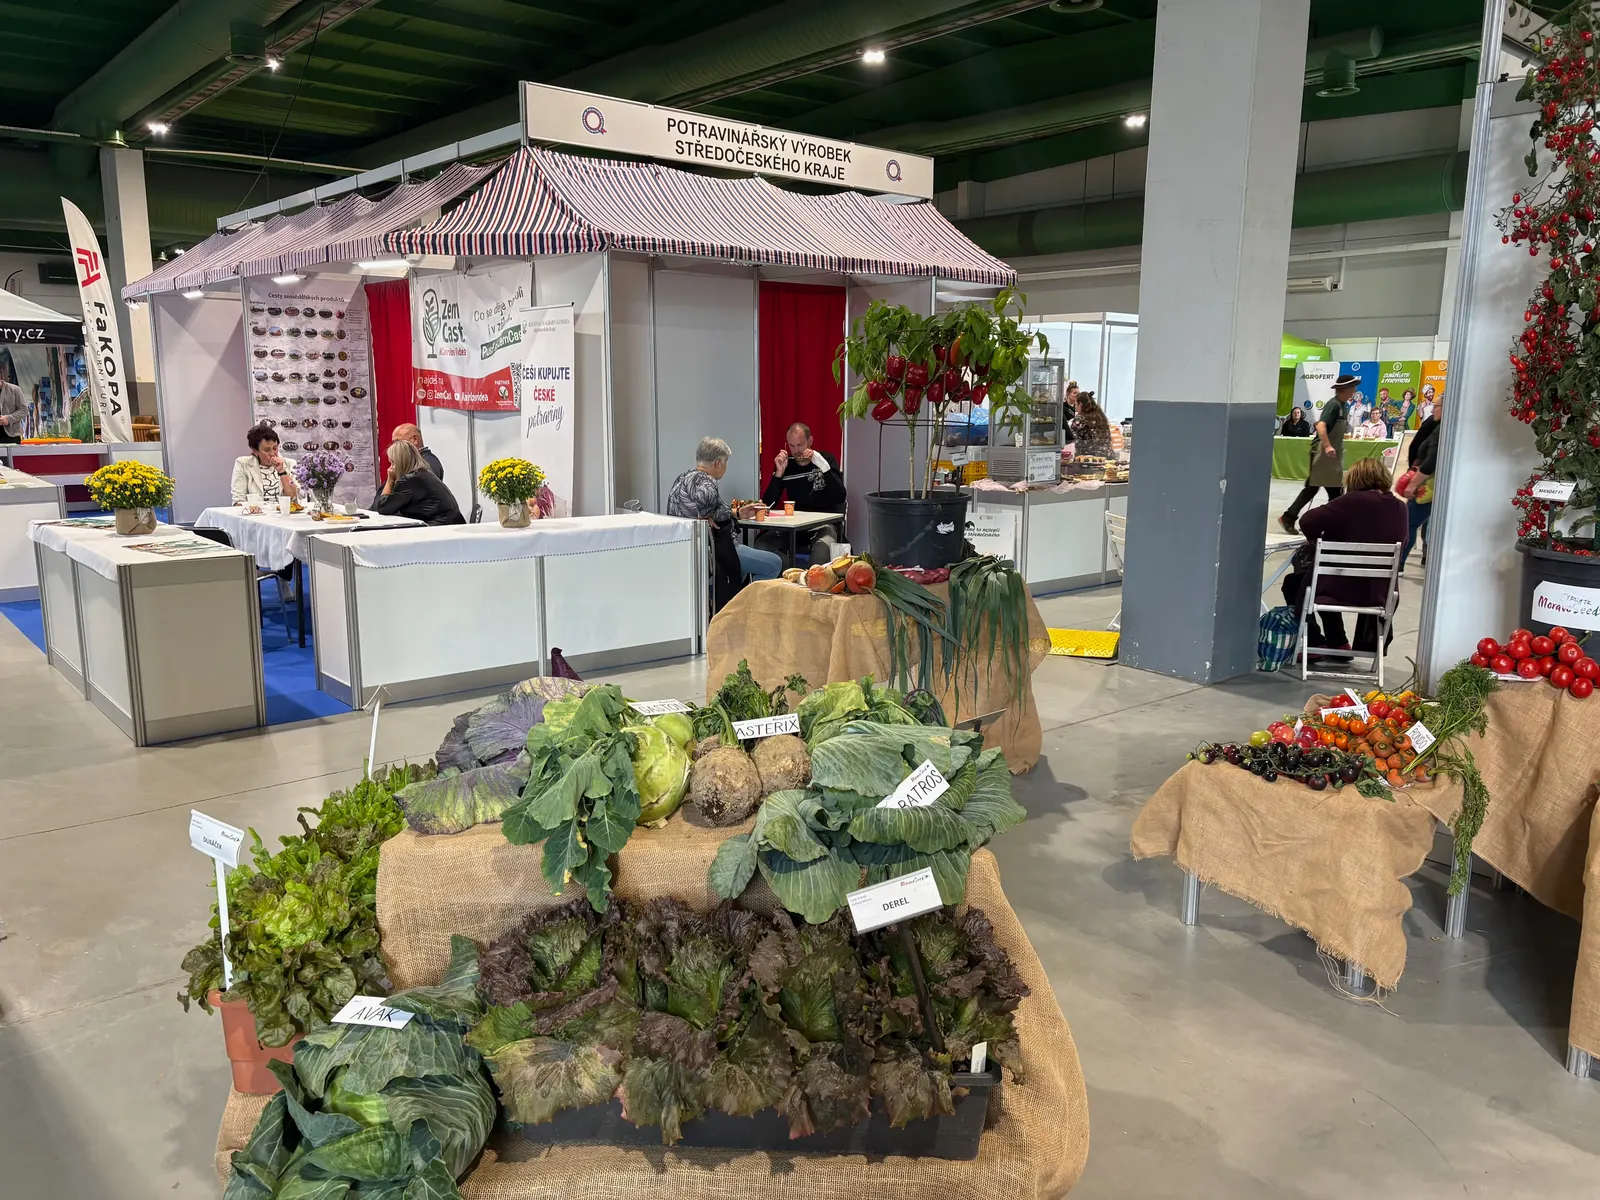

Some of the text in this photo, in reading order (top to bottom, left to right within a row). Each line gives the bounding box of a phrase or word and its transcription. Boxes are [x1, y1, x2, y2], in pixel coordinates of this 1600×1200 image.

[667, 117, 852, 163] POTRAVINÁŘSKÝ VÝROBEK
[675, 139, 845, 181] STŘEDOČESKÉHO KRAJE
[268, 292, 283, 300] Cesty
[283, 294, 320, 302] zemědělských
[441, 299, 460, 320] Zem
[474, 310, 485, 322] Co
[486, 308, 493, 318] se
[442, 321, 466, 343] Cast
[522, 364, 571, 380] ČEŠI KUPUJTE
[533, 385, 556, 402] ČESKÉ
[526, 404, 565, 439] potraviny
[736, 719, 799, 737] ASTERIX
[897, 769, 943, 809] BATROS
[882, 896, 910, 911] DEREL
[349, 1006, 400, 1022] AVAK
